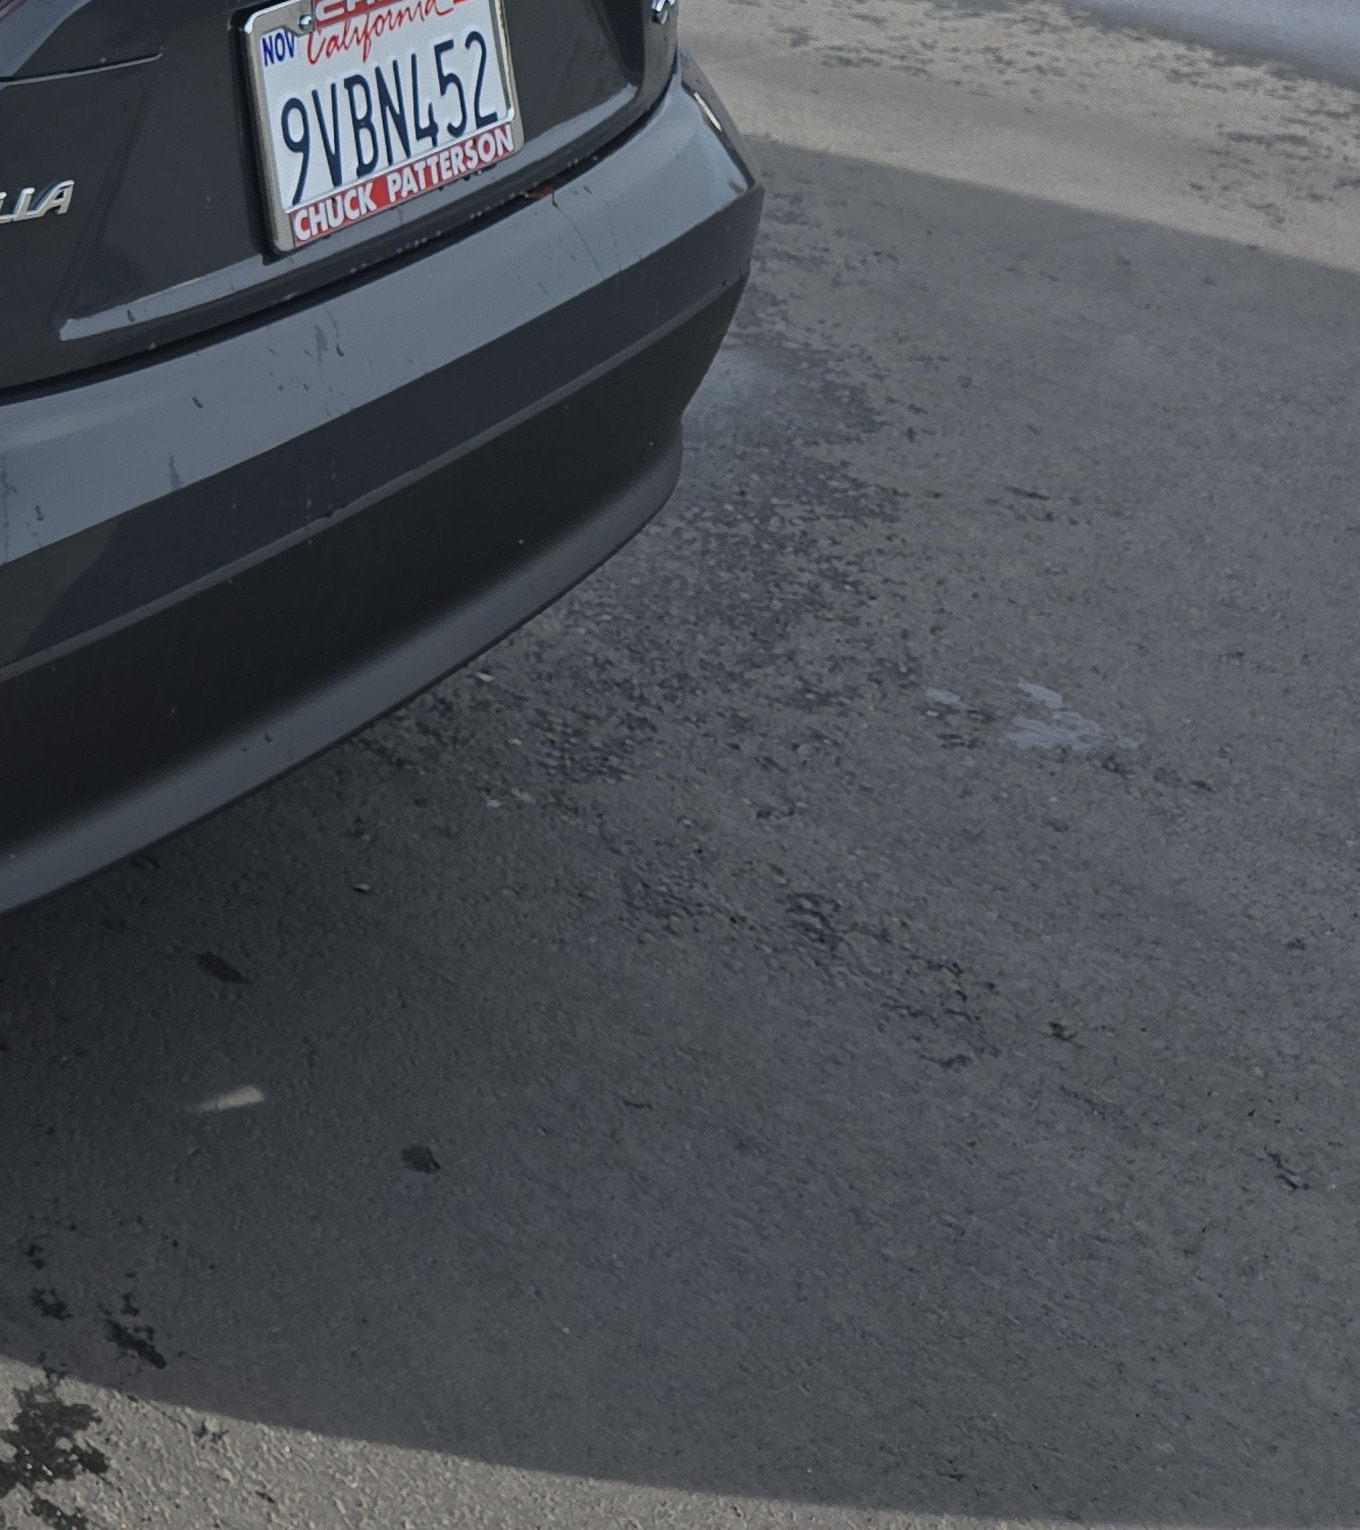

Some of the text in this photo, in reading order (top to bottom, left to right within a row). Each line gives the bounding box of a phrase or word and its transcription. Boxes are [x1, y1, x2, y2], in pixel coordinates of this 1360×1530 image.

[261, 31, 296, 68] NOV
[281, 30, 498, 206] 9VBN452
[293, 125, 514, 243] CHUCK PATTERSON
